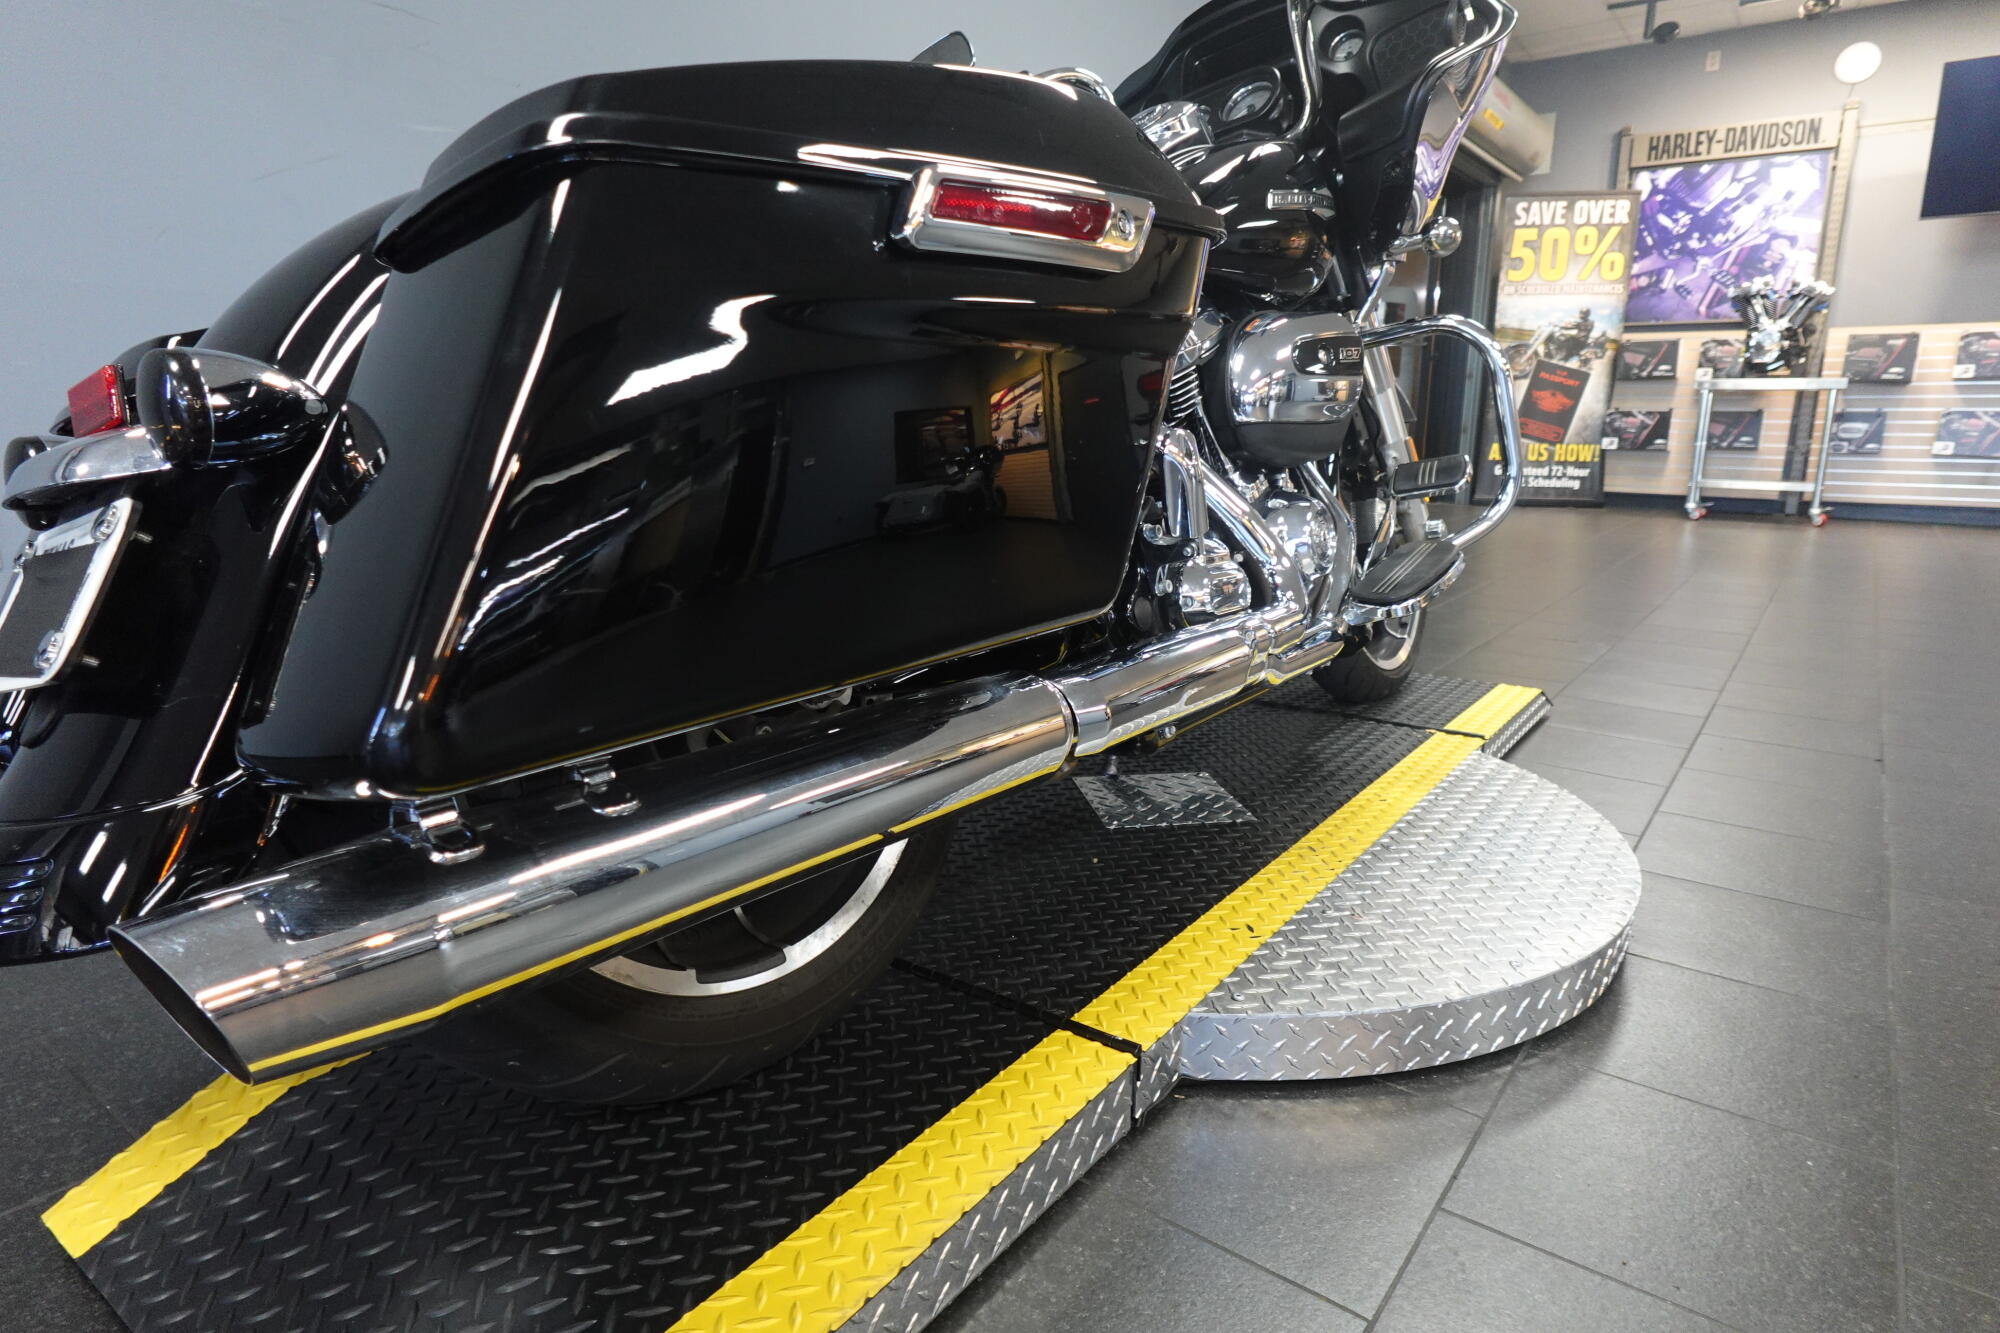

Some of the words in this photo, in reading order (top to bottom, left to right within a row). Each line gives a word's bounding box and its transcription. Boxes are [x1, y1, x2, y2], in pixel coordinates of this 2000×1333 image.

[1647, 117, 1822, 162] HARLEY-DAVIDSON
[1514, 200, 1568, 226] SAVE
[1573, 199, 1631, 225] OVER
[1507, 225, 1626, 282] 50%
[1527, 443, 1550, 462] US
[1553, 443, 1600, 462] HOW!
[1551, 465, 1591, 477] 72-Hour
[1527, 477, 1581, 490] Scheduling
